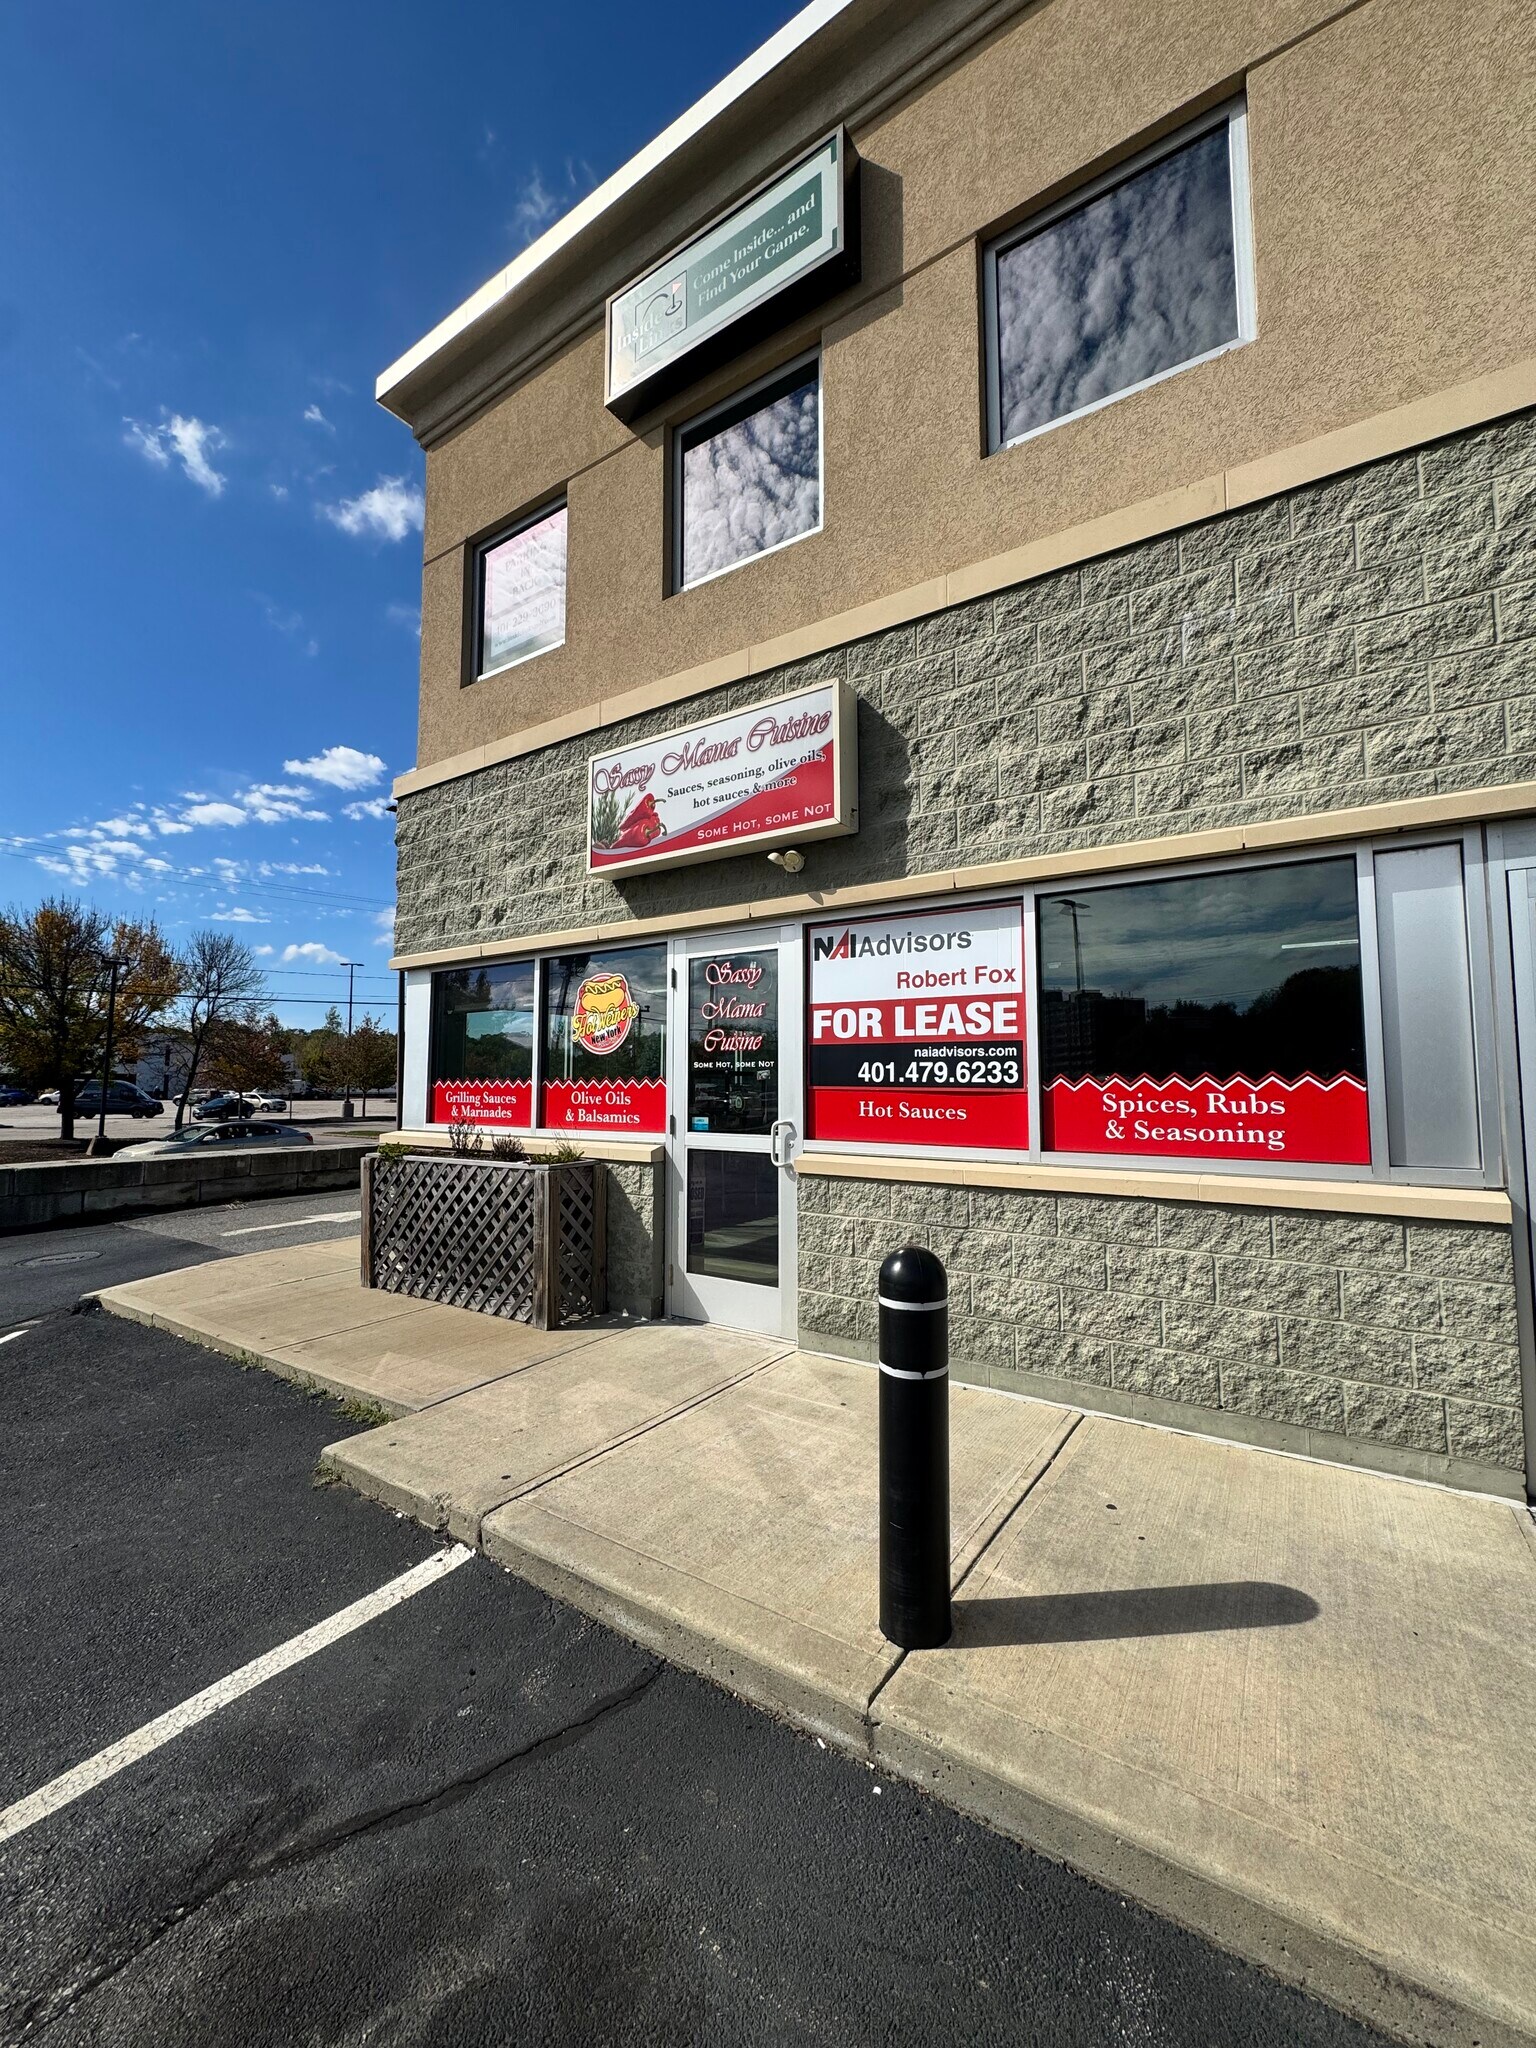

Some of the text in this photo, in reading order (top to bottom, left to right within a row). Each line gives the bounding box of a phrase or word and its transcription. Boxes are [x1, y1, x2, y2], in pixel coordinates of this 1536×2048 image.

[693, 193, 816, 290] Come Inside... and
[698, 225, 810, 307] Find Your Game.
[593, 710, 832, 794] Sassy Mama Cuisine
[667, 749, 826, 798] Sauces, seasoning, olive oils,
[693, 775, 797, 809] hot sauces & more
[814, 927, 973, 961] NAI Advisors
[705, 961, 762, 989] Sassy
[897, 965, 1017, 989] Robert Fox
[701, 997, 766, 1020] Mama
[813, 1000, 1019, 1039] FOR LEASE
[704, 1028, 763, 1052] Cuisine
[914, 1046, 1018, 1058] naiadvisors.com
[858, 1061, 1019, 1084] 401.479.6233
[445, 1091, 517, 1106] Grilling Sauces
[571, 1091, 632, 1105] Olive Oils
[1102, 1092, 1286, 1118] Spices, Rubs
[451, 1105, 513, 1119] & Marinades
[565, 1109, 641, 1124] & Balsamics
[858, 1101, 967, 1121] Hot Sauces
[1105, 1119, 1286, 1151] & Seasoning
